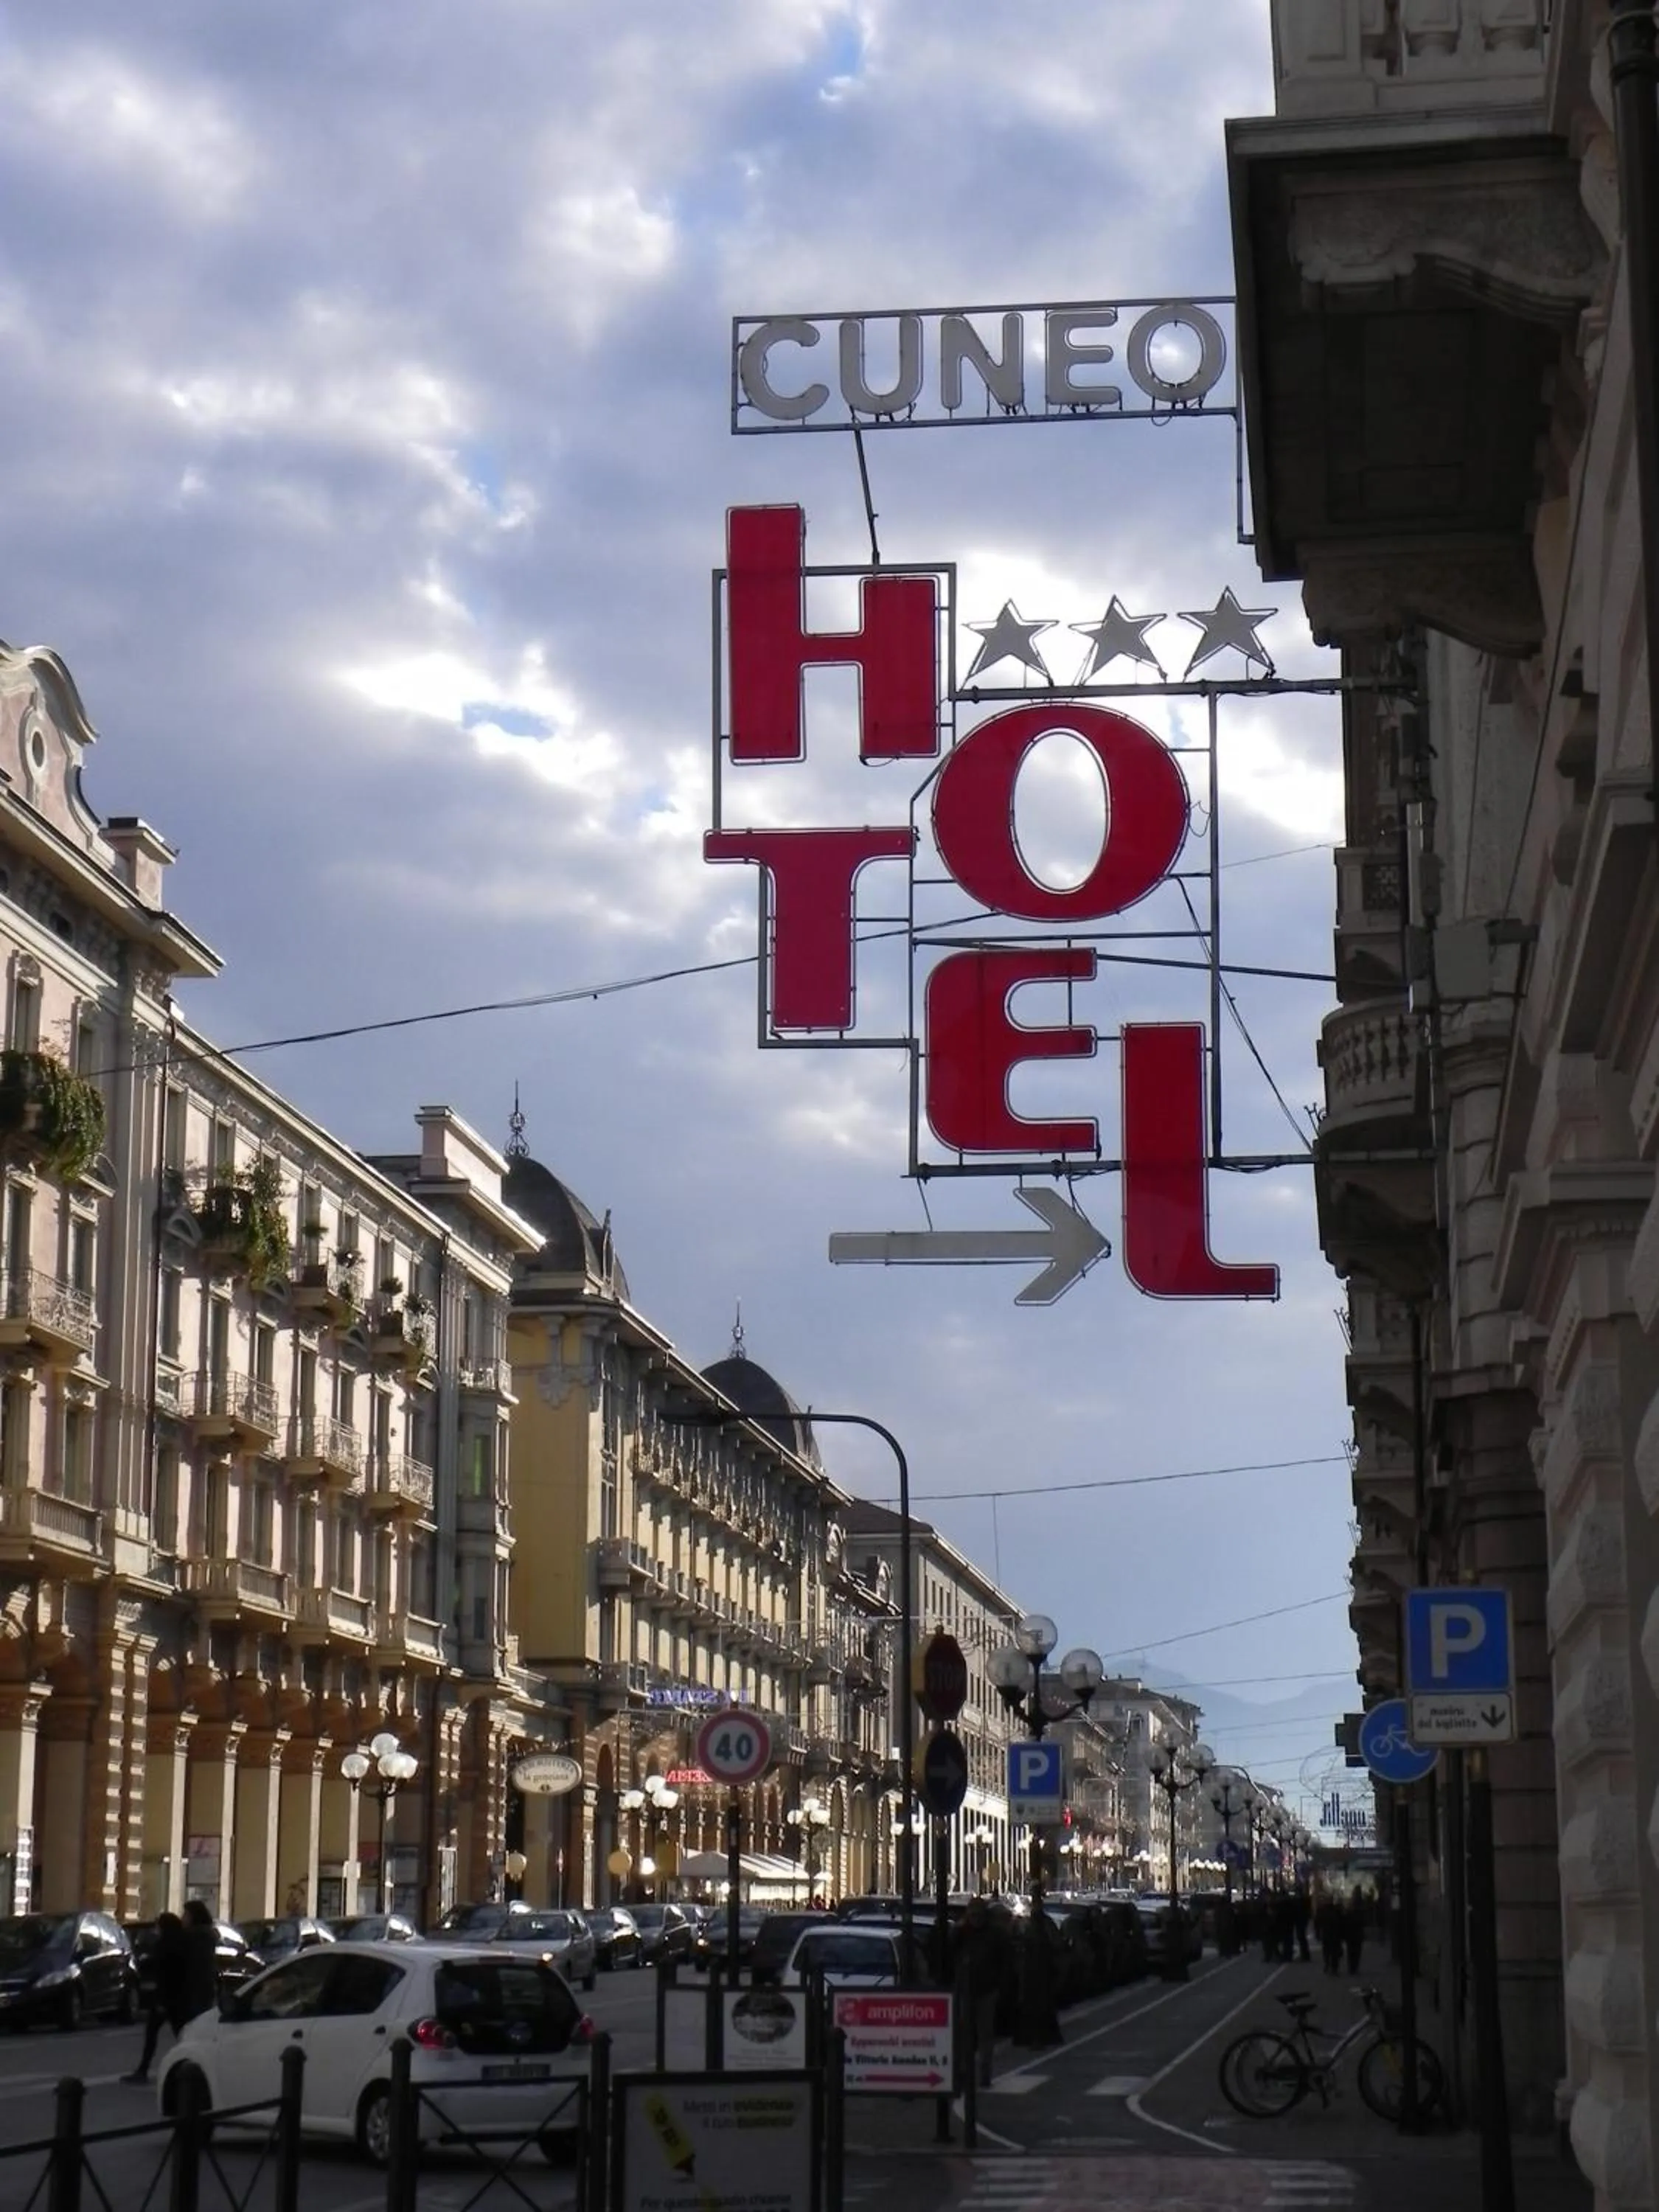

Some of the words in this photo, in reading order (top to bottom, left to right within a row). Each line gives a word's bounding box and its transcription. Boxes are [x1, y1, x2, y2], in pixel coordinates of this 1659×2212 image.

[740, 303, 1227, 420] CUNEO
[704, 503, 1280, 1301] HOTEL
[1429, 1604, 1486, 1679] P
[715, 1733, 753, 1761] 40
[1019, 1750, 1050, 1790] P
[866, 2003, 936, 2024] amplifon
